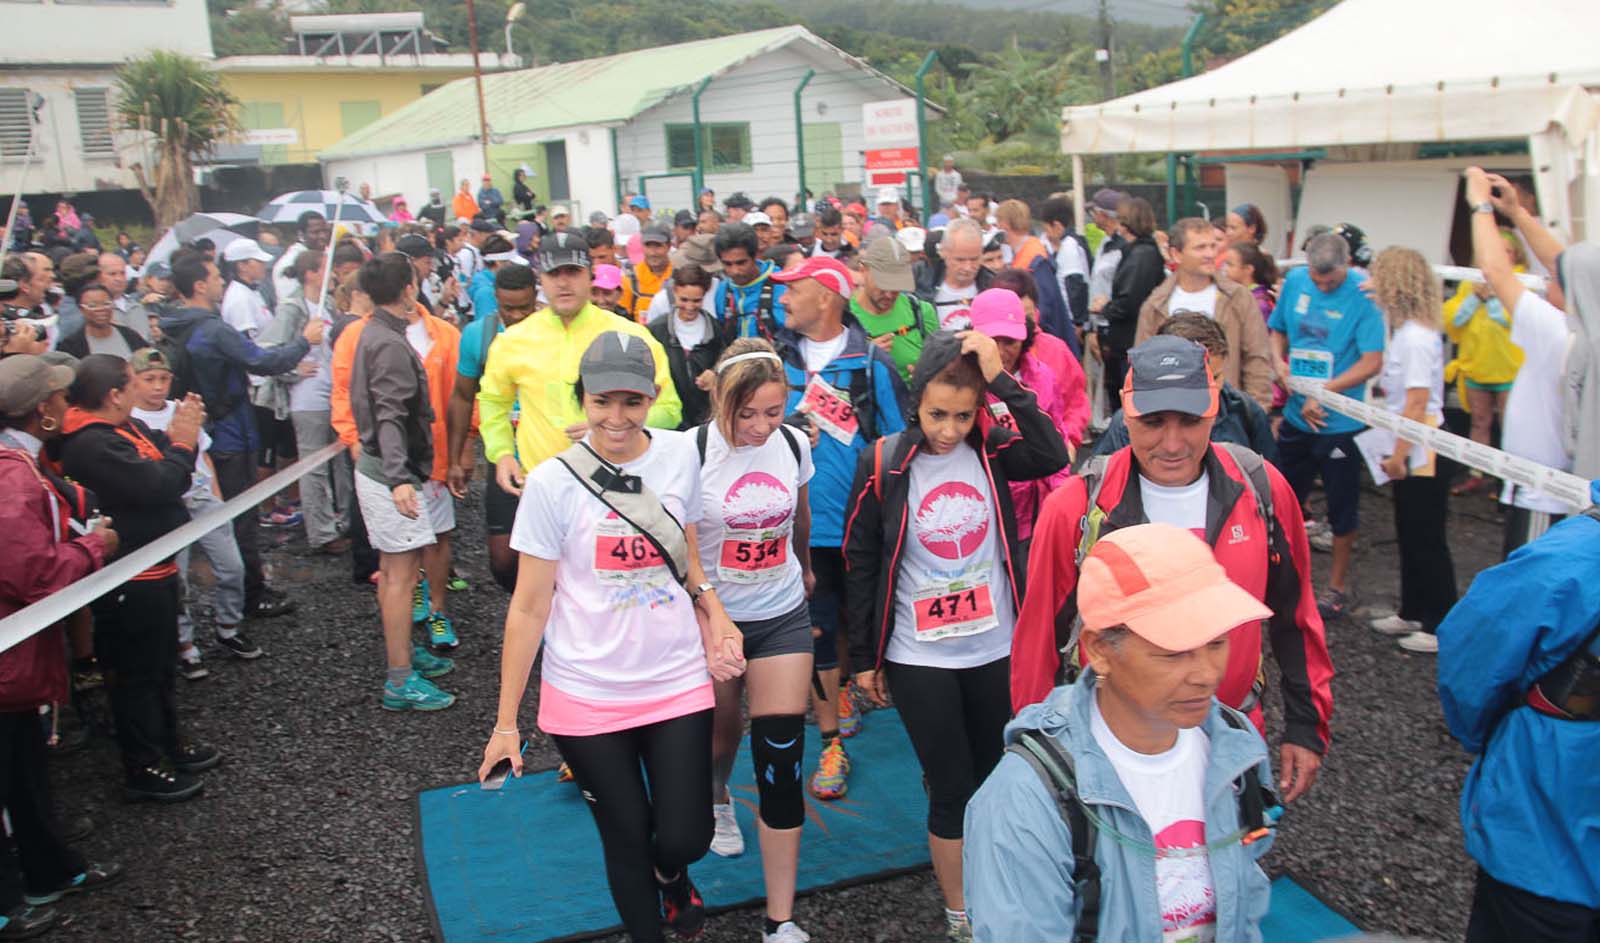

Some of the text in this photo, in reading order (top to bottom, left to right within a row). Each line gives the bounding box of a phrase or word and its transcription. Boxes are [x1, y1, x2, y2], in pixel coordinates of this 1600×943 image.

[611, 537, 662, 561] 46
[736, 538, 779, 562] 534
[928, 590, 977, 619] 471
